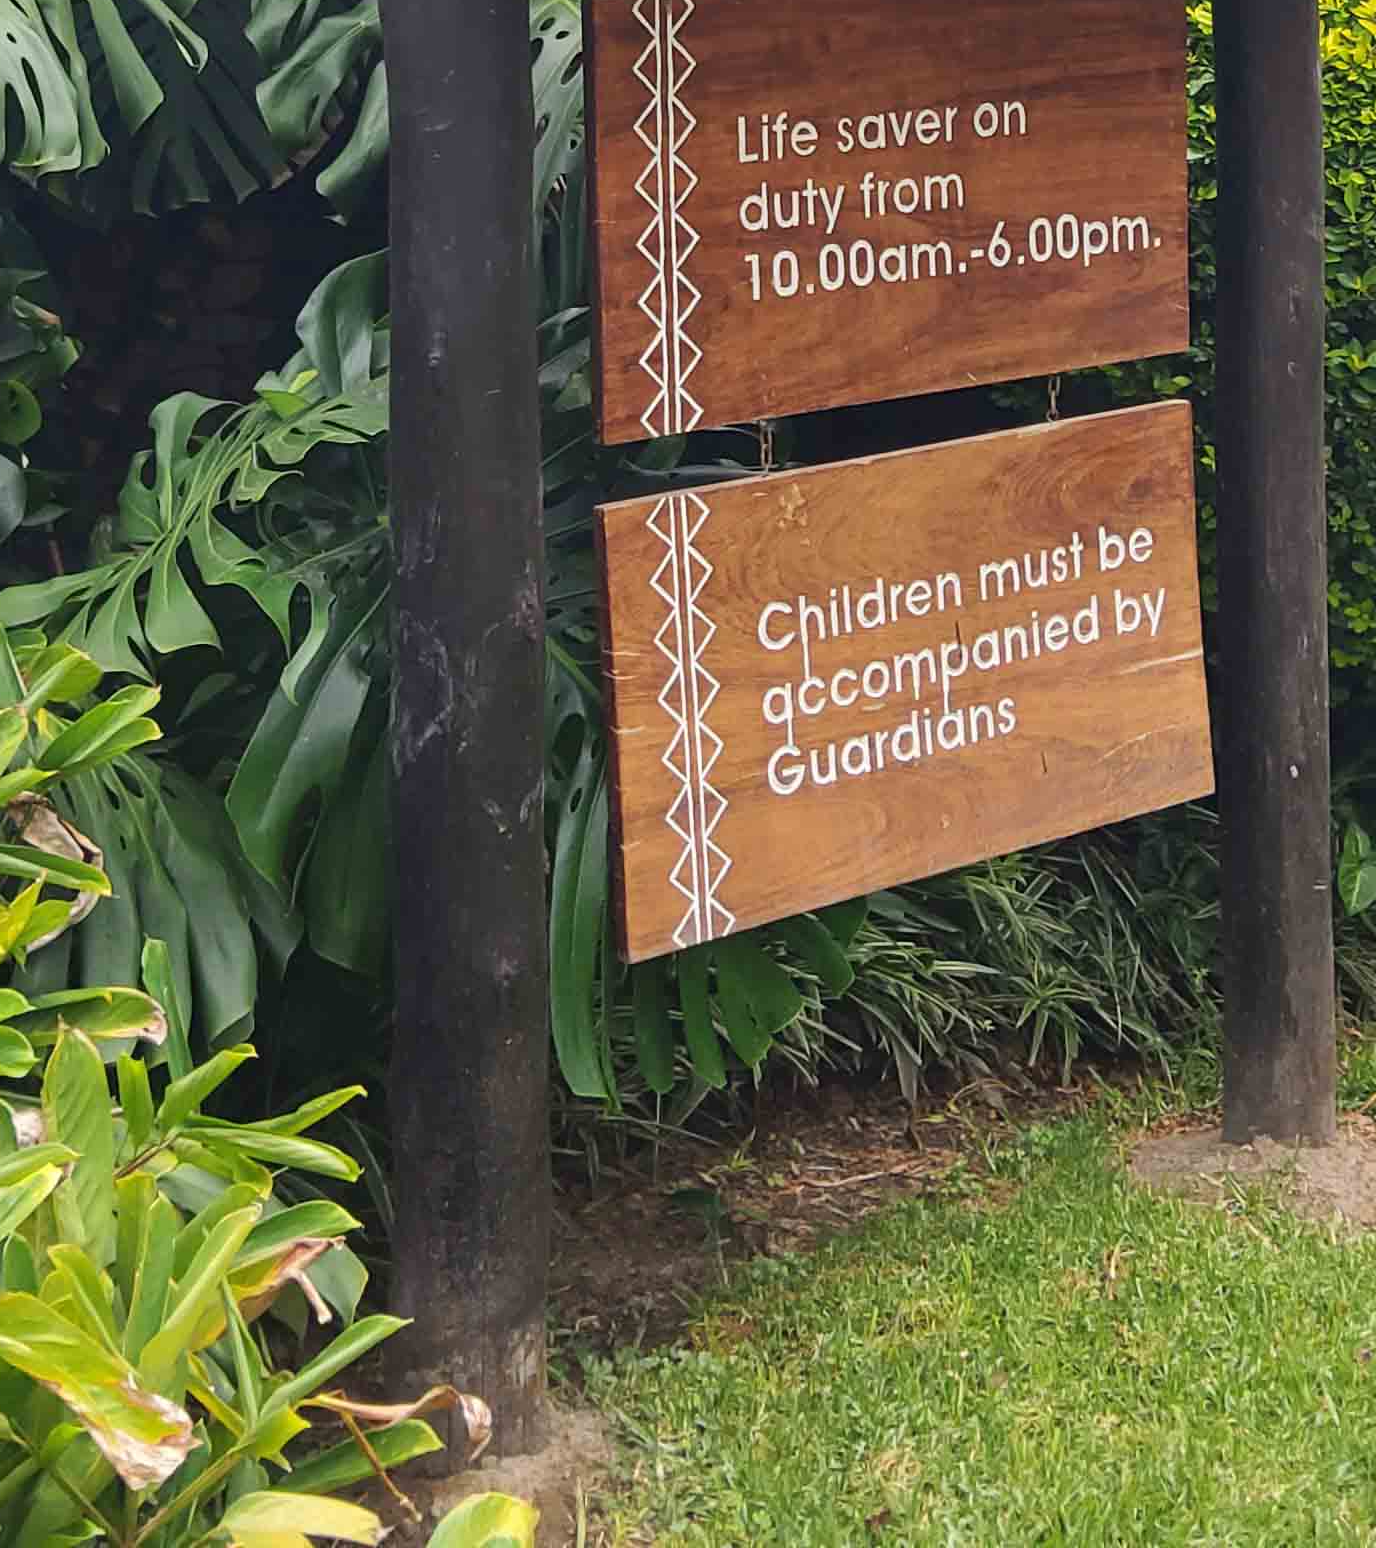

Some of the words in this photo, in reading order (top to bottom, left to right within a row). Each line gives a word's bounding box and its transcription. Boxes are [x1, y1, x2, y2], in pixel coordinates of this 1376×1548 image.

[736, 111, 818, 164] Life
[837, 105, 960, 154] saver
[973, 99, 1028, 138] on
[738, 179, 845, 235] duty
[859, 171, 965, 219] from
[756, 572, 962, 651] Children
[978, 532, 1084, 601] must
[1097, 525, 1155, 573] be
[761, 595, 1101, 725] accompanied
[1113, 587, 1167, 637] by
[766, 695, 1018, 796] Guardians
